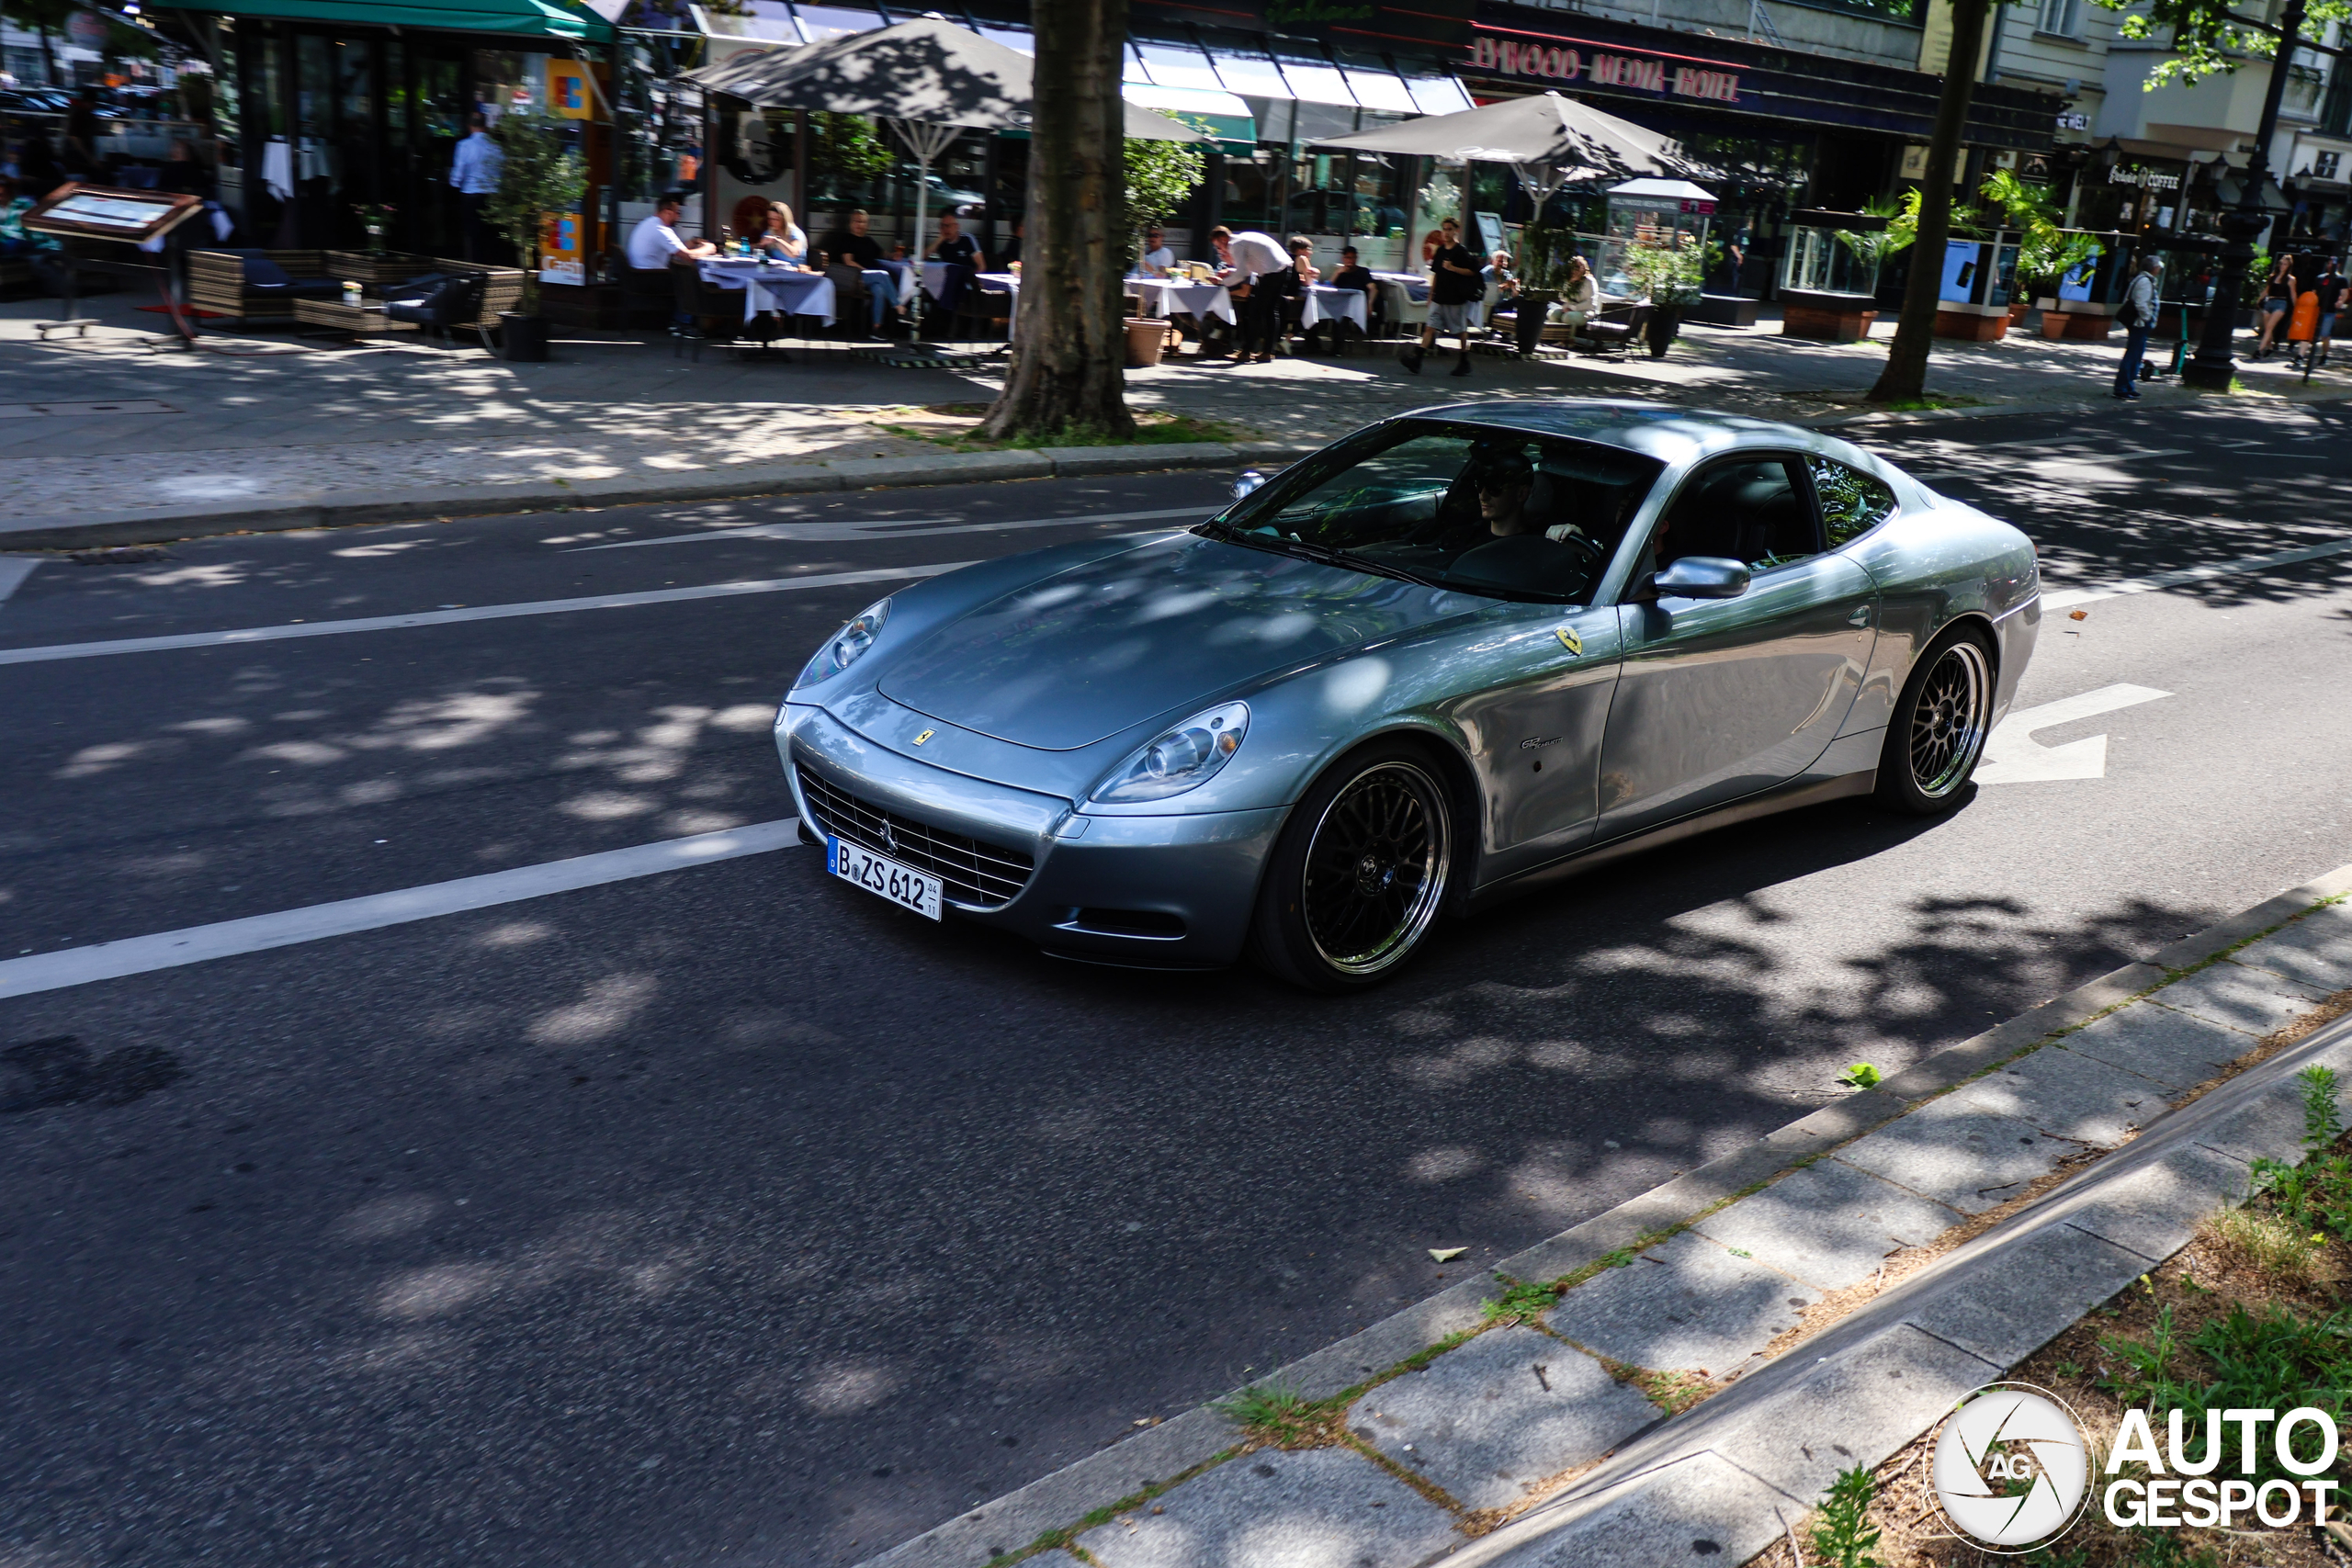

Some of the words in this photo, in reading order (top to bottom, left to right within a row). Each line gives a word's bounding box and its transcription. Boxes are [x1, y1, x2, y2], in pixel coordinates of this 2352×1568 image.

[1464, 36, 1581, 79] LYWOOD
[1589, 53, 1666, 92] MEDIA
[1674, 67, 1741, 103] HOTEL
[2147, 173, 2180, 189] COFFEE
[541, 255, 585, 275] Cash
[839, 845, 850, 875] B
[861, 854, 885, 892] ZS
[889, 868, 925, 911] 612
[927, 883, 937, 894] 04
[928, 904, 935, 915] 11
